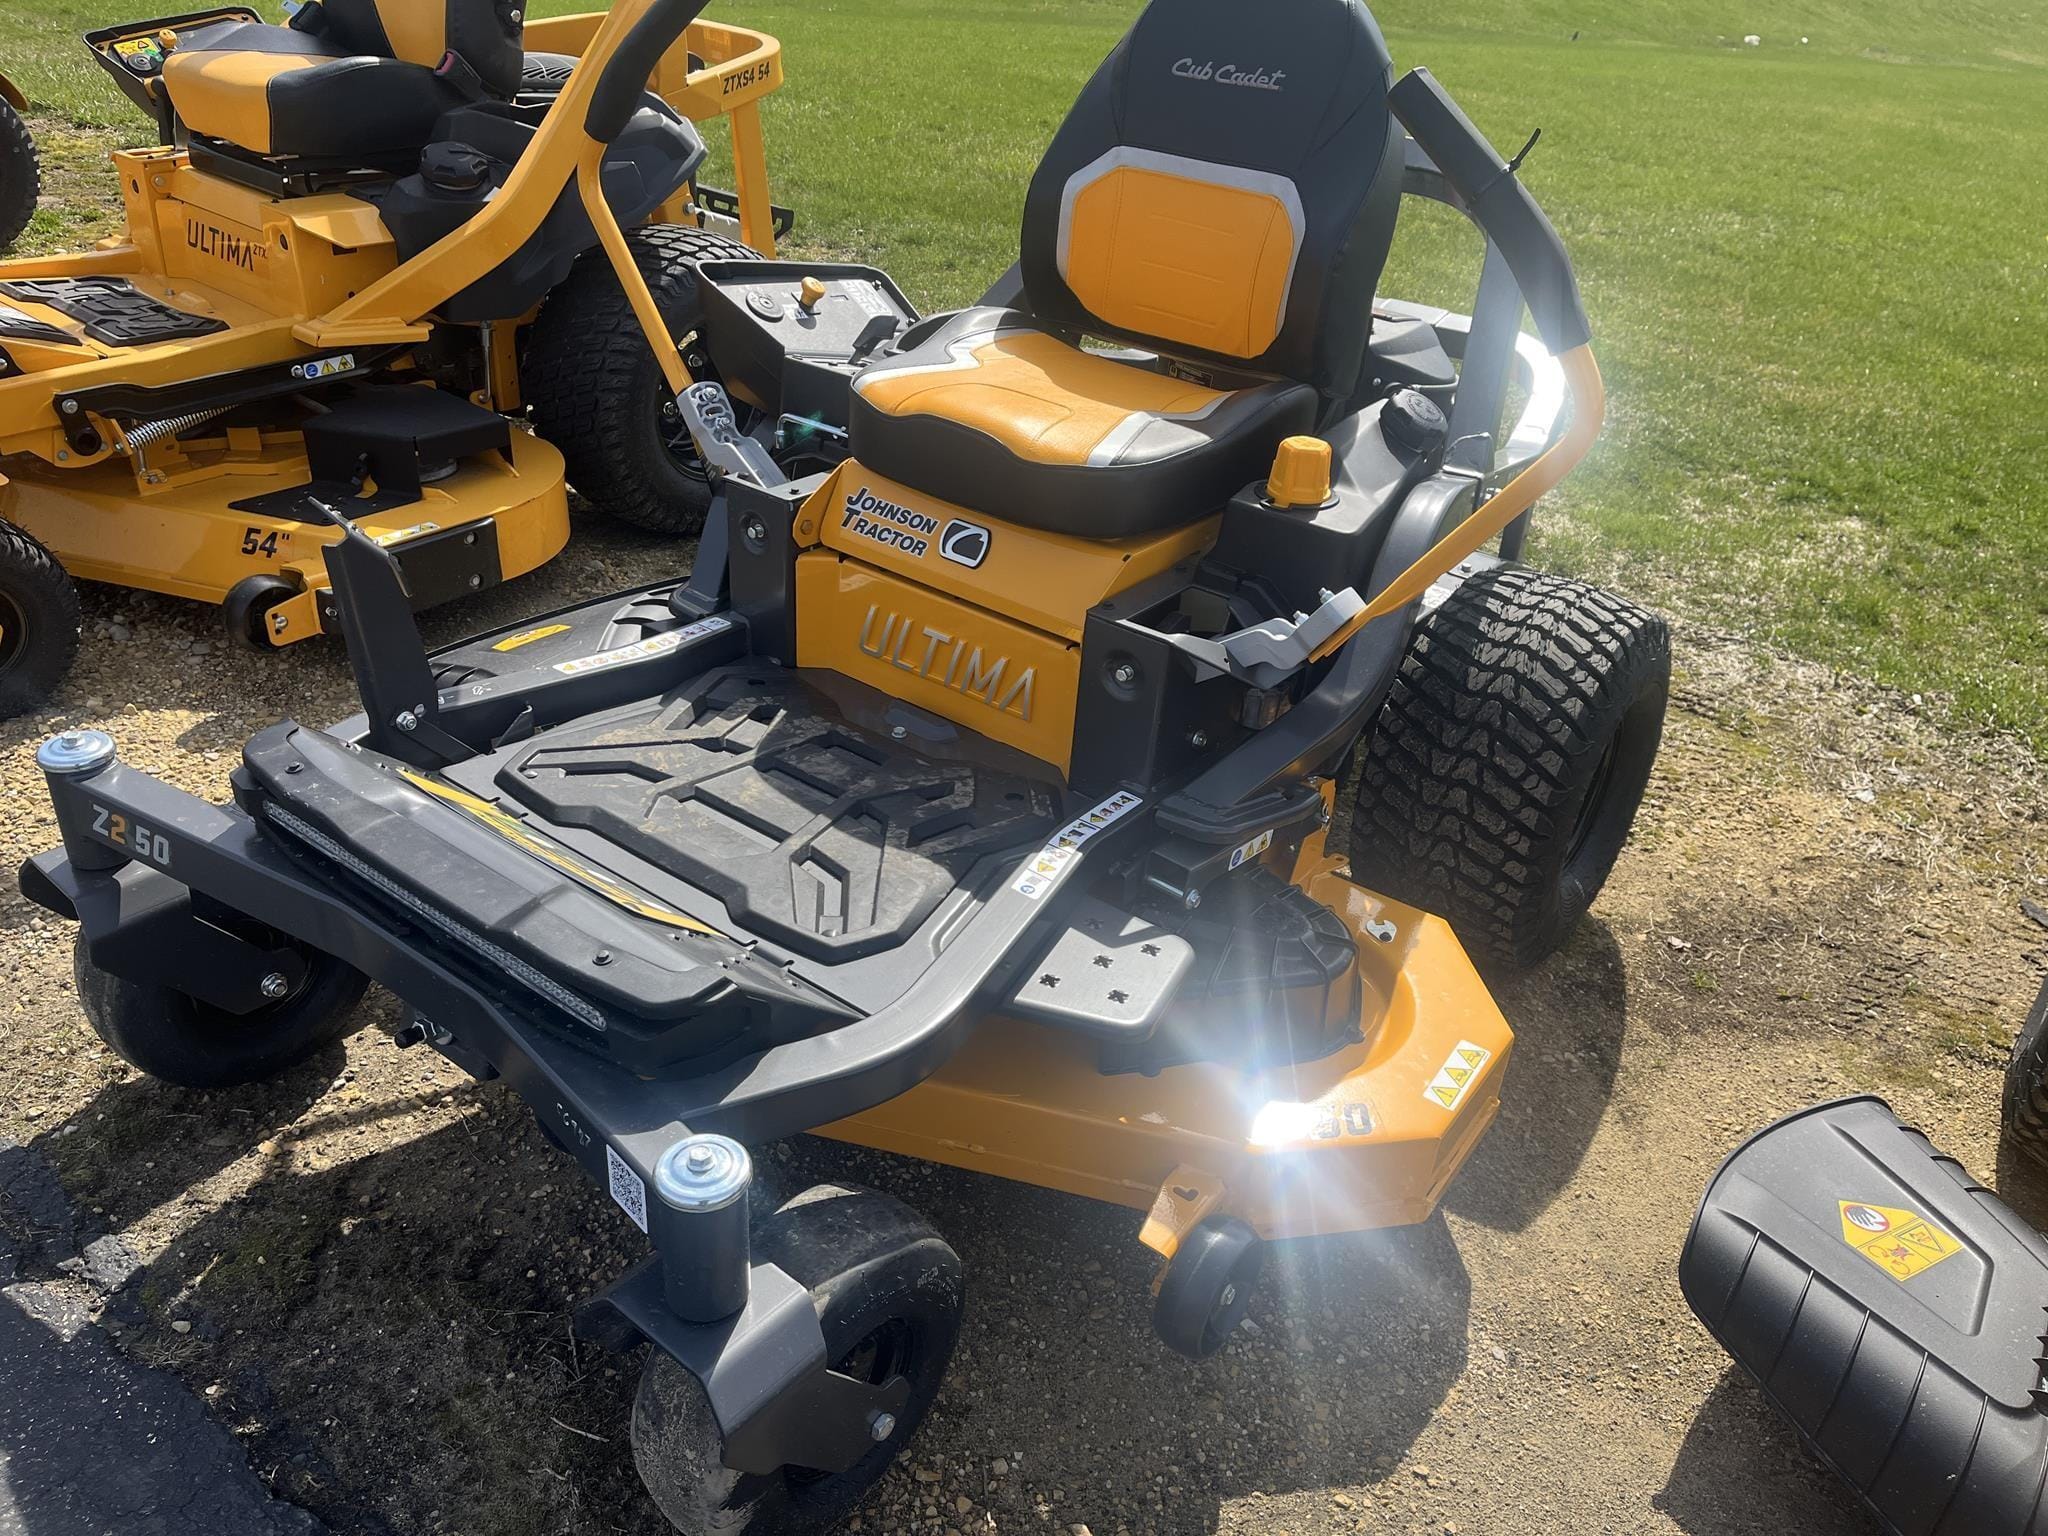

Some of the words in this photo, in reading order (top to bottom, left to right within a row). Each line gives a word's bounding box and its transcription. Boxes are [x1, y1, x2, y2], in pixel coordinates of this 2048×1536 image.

[723, 67, 755, 95] ZTXS4
[758, 61, 770, 81] 54
[1171, 58, 1213, 80] Cub
[1214, 64, 1286, 90] Cadet
[187, 218, 254, 272] ULTIMA
[859, 602, 1037, 722] ULTIMA
[92, 803, 126, 845] Z2
[135, 824, 170, 865] 50
